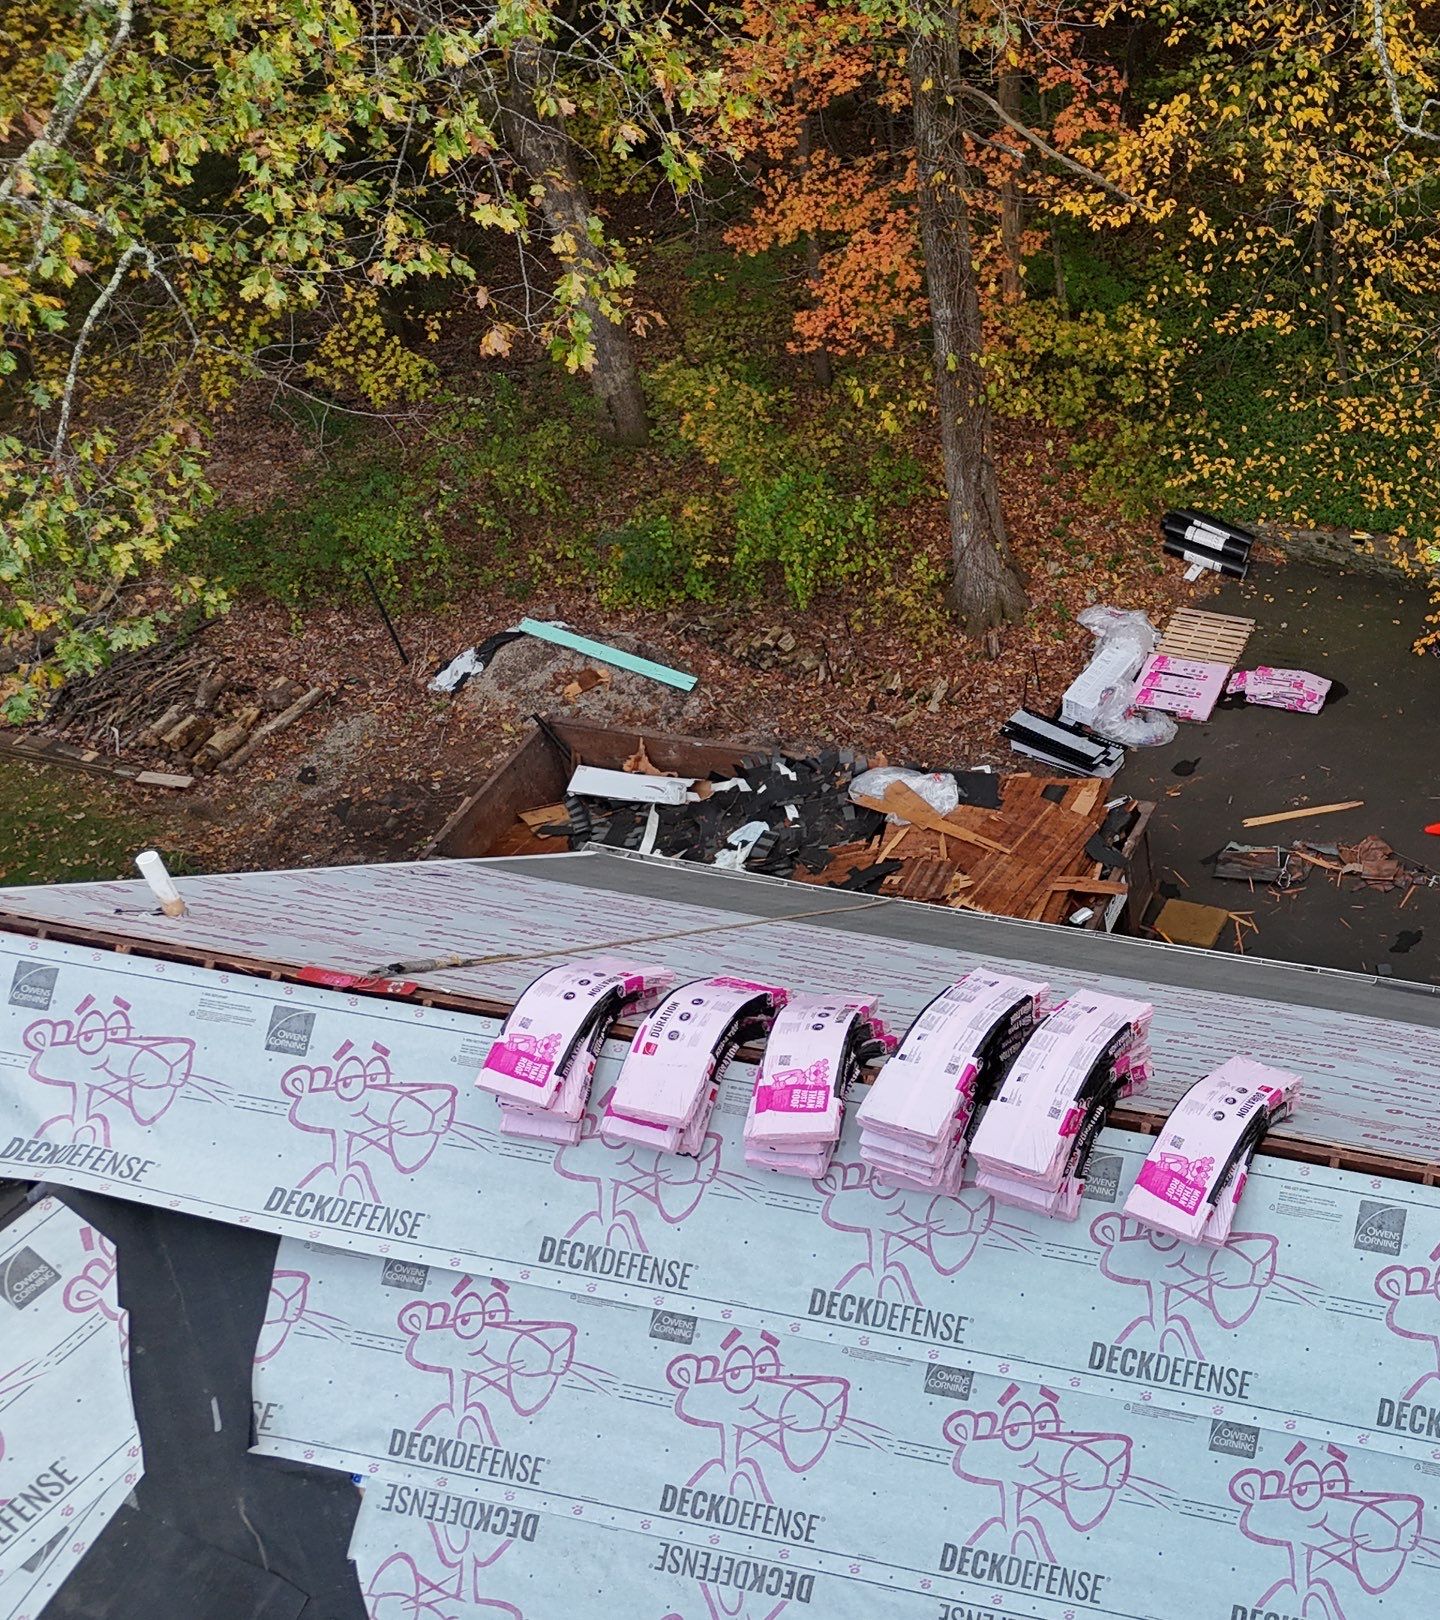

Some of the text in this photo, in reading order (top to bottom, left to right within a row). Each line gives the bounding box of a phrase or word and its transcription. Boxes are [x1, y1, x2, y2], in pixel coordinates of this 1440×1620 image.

[13, 991, 49, 1005] CORNING
[21, 984, 52, 997] OWENS
[651, 1002, 680, 1038] DURATION
[269, 1036, 306, 1050] CORNING
[278, 1029, 308, 1042] OWENS
[1236, 1092, 1265, 1118] DURATION
[0, 1137, 155, 1182] DECKDEFENSE
[1166, 1178, 1177, 1200] ROOF
[1182, 1183, 1195, 1207] THAN
[1189, 1188, 1201, 1211] MORE
[264, 1187, 427, 1240] DECKDEFENSE
[1358, 1234, 1399, 1249] CORNING
[1367, 1227, 1400, 1240] OWENS
[394, 1264, 426, 1277] OWENS
[540, 1236, 691, 1291] DECKDEFENSE
[13, 1264, 51, 1292] OWENS
[13, 1268, 55, 1303] CORNING
[385, 1271, 424, 1286] CORNING
[662, 1316, 694, 1329] OWENS
[808, 1288, 968, 1344] DECKDEFENSE
[653, 1323, 692, 1338] CORNING
[937, 1370, 970, 1385] OWENS
[1088, 1341, 1253, 1399] DECKDEFENSE
[928, 1378, 969, 1394] CORNING
[1213, 1435, 1254, 1452] CORNING
[1222, 1428, 1256, 1443] OWENS
[388, 1428, 548, 1485] DECKDEFENSE
[384, 1482, 539, 1541] DECKDEFENSE
[659, 1483, 820, 1543] DECKDEFENSE
[656, 1545, 814, 1603] DECKDEFENSE
[940, 1542, 1106, 1603] DECKDEFENSE
